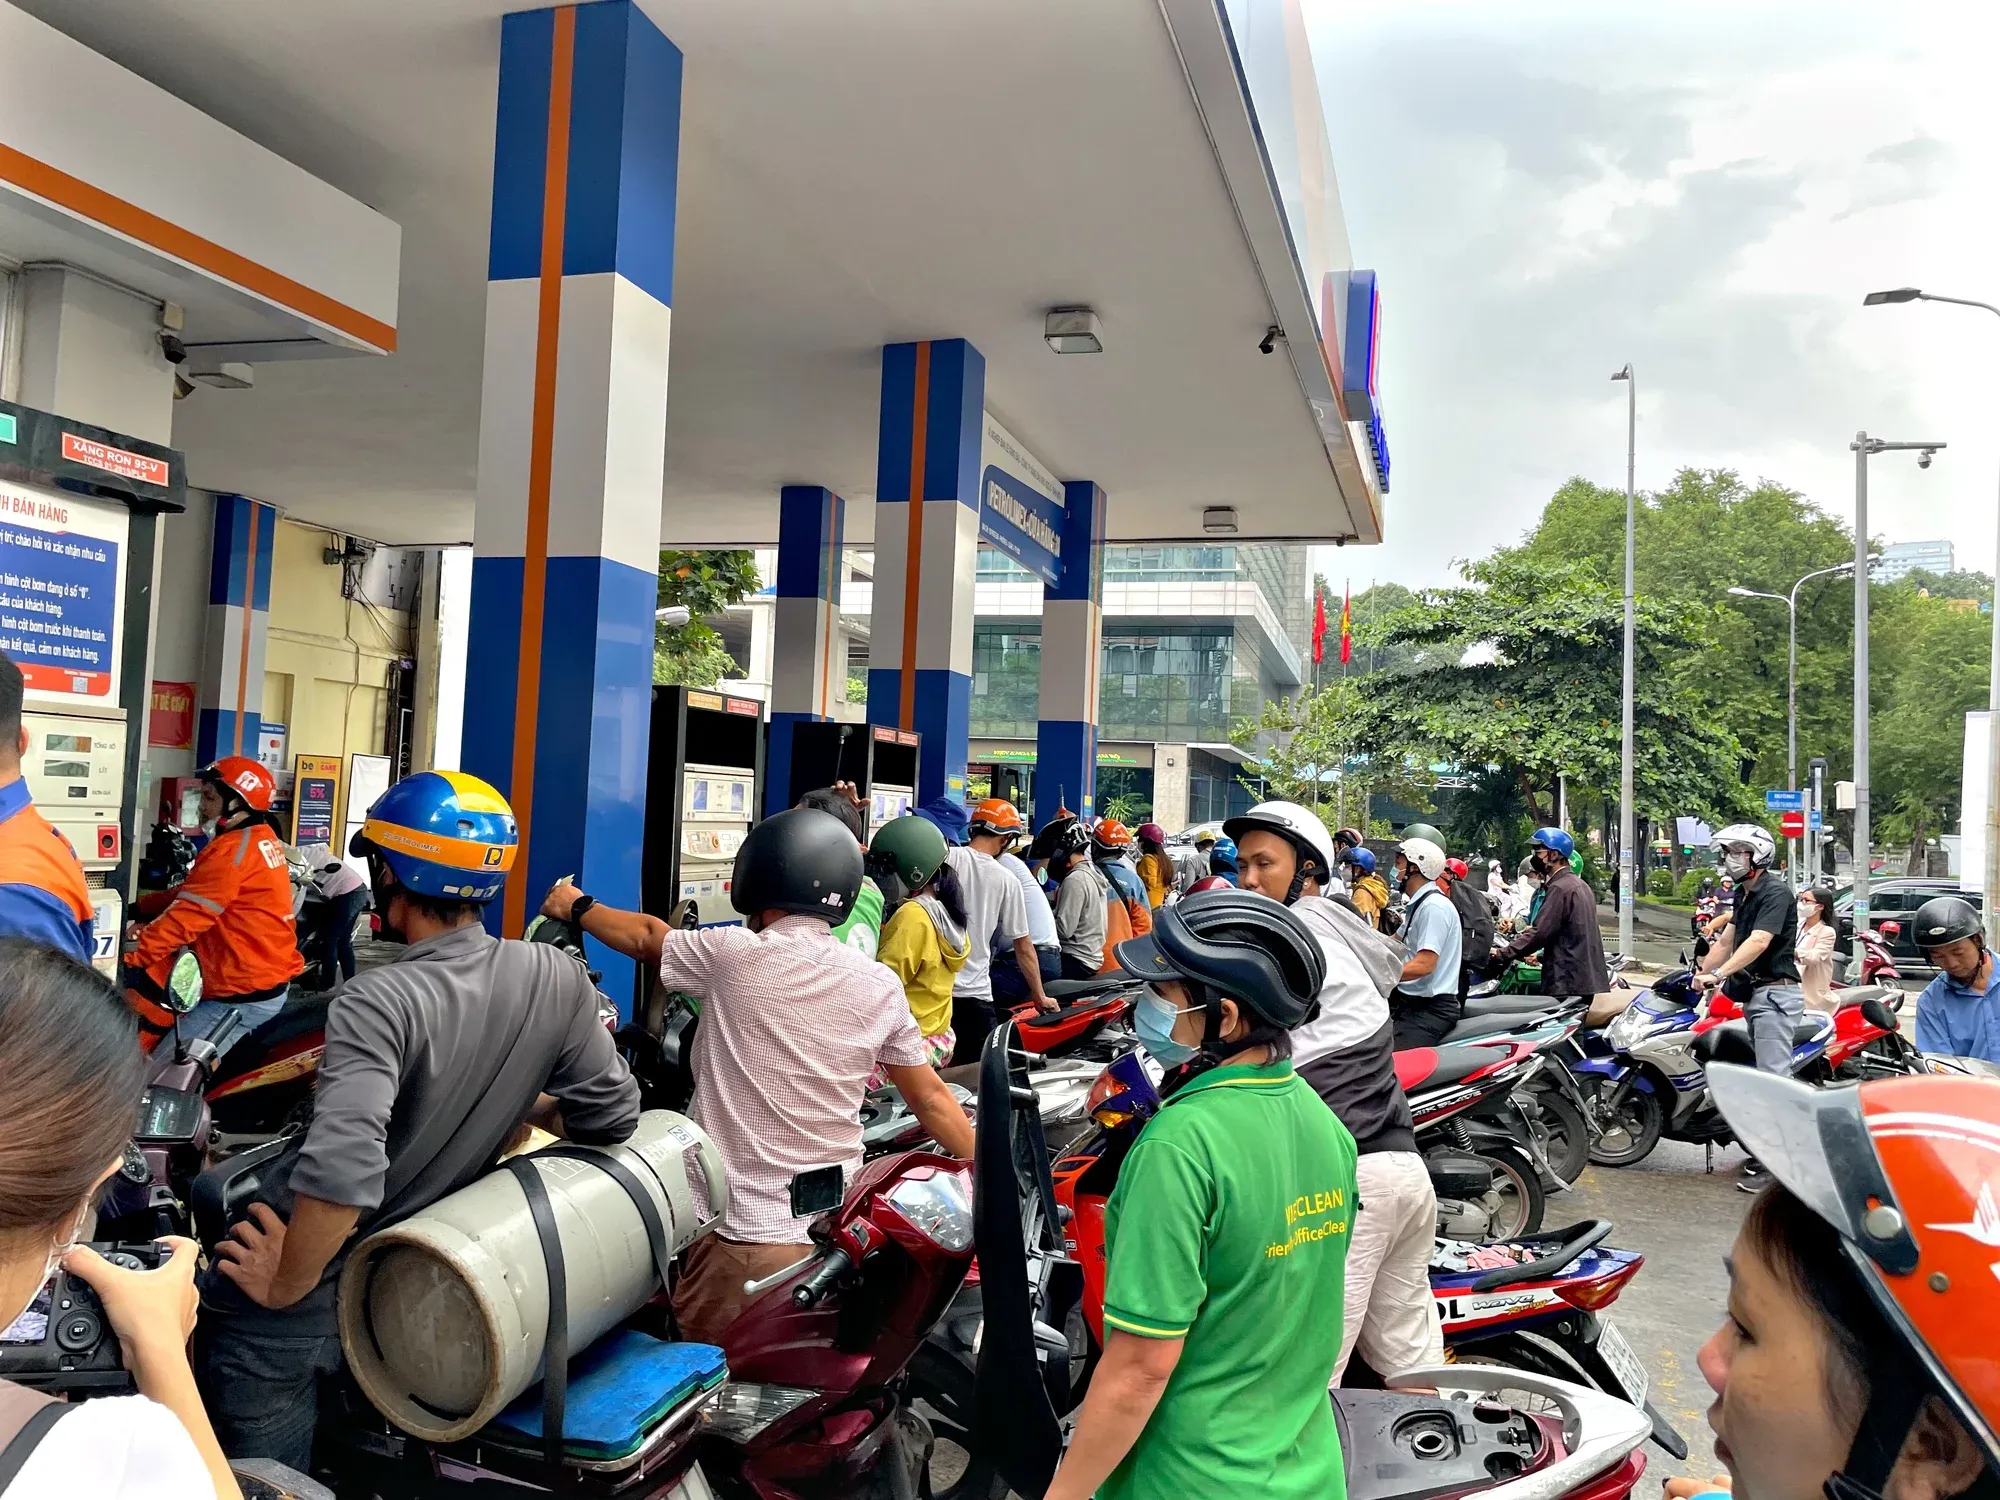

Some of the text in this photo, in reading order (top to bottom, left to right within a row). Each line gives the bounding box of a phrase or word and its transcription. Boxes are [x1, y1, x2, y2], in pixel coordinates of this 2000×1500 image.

[73, 440, 158, 473] XĂNG RON 95-V
[13, 498, 36, 516] BÁN
[38, 503, 68, 524] HÀNG
[302, 761, 314, 770] be
[310, 787, 325, 798] 5%
[685, 887, 695, 895] VISA
[673, 1128, 689, 1142] 25
